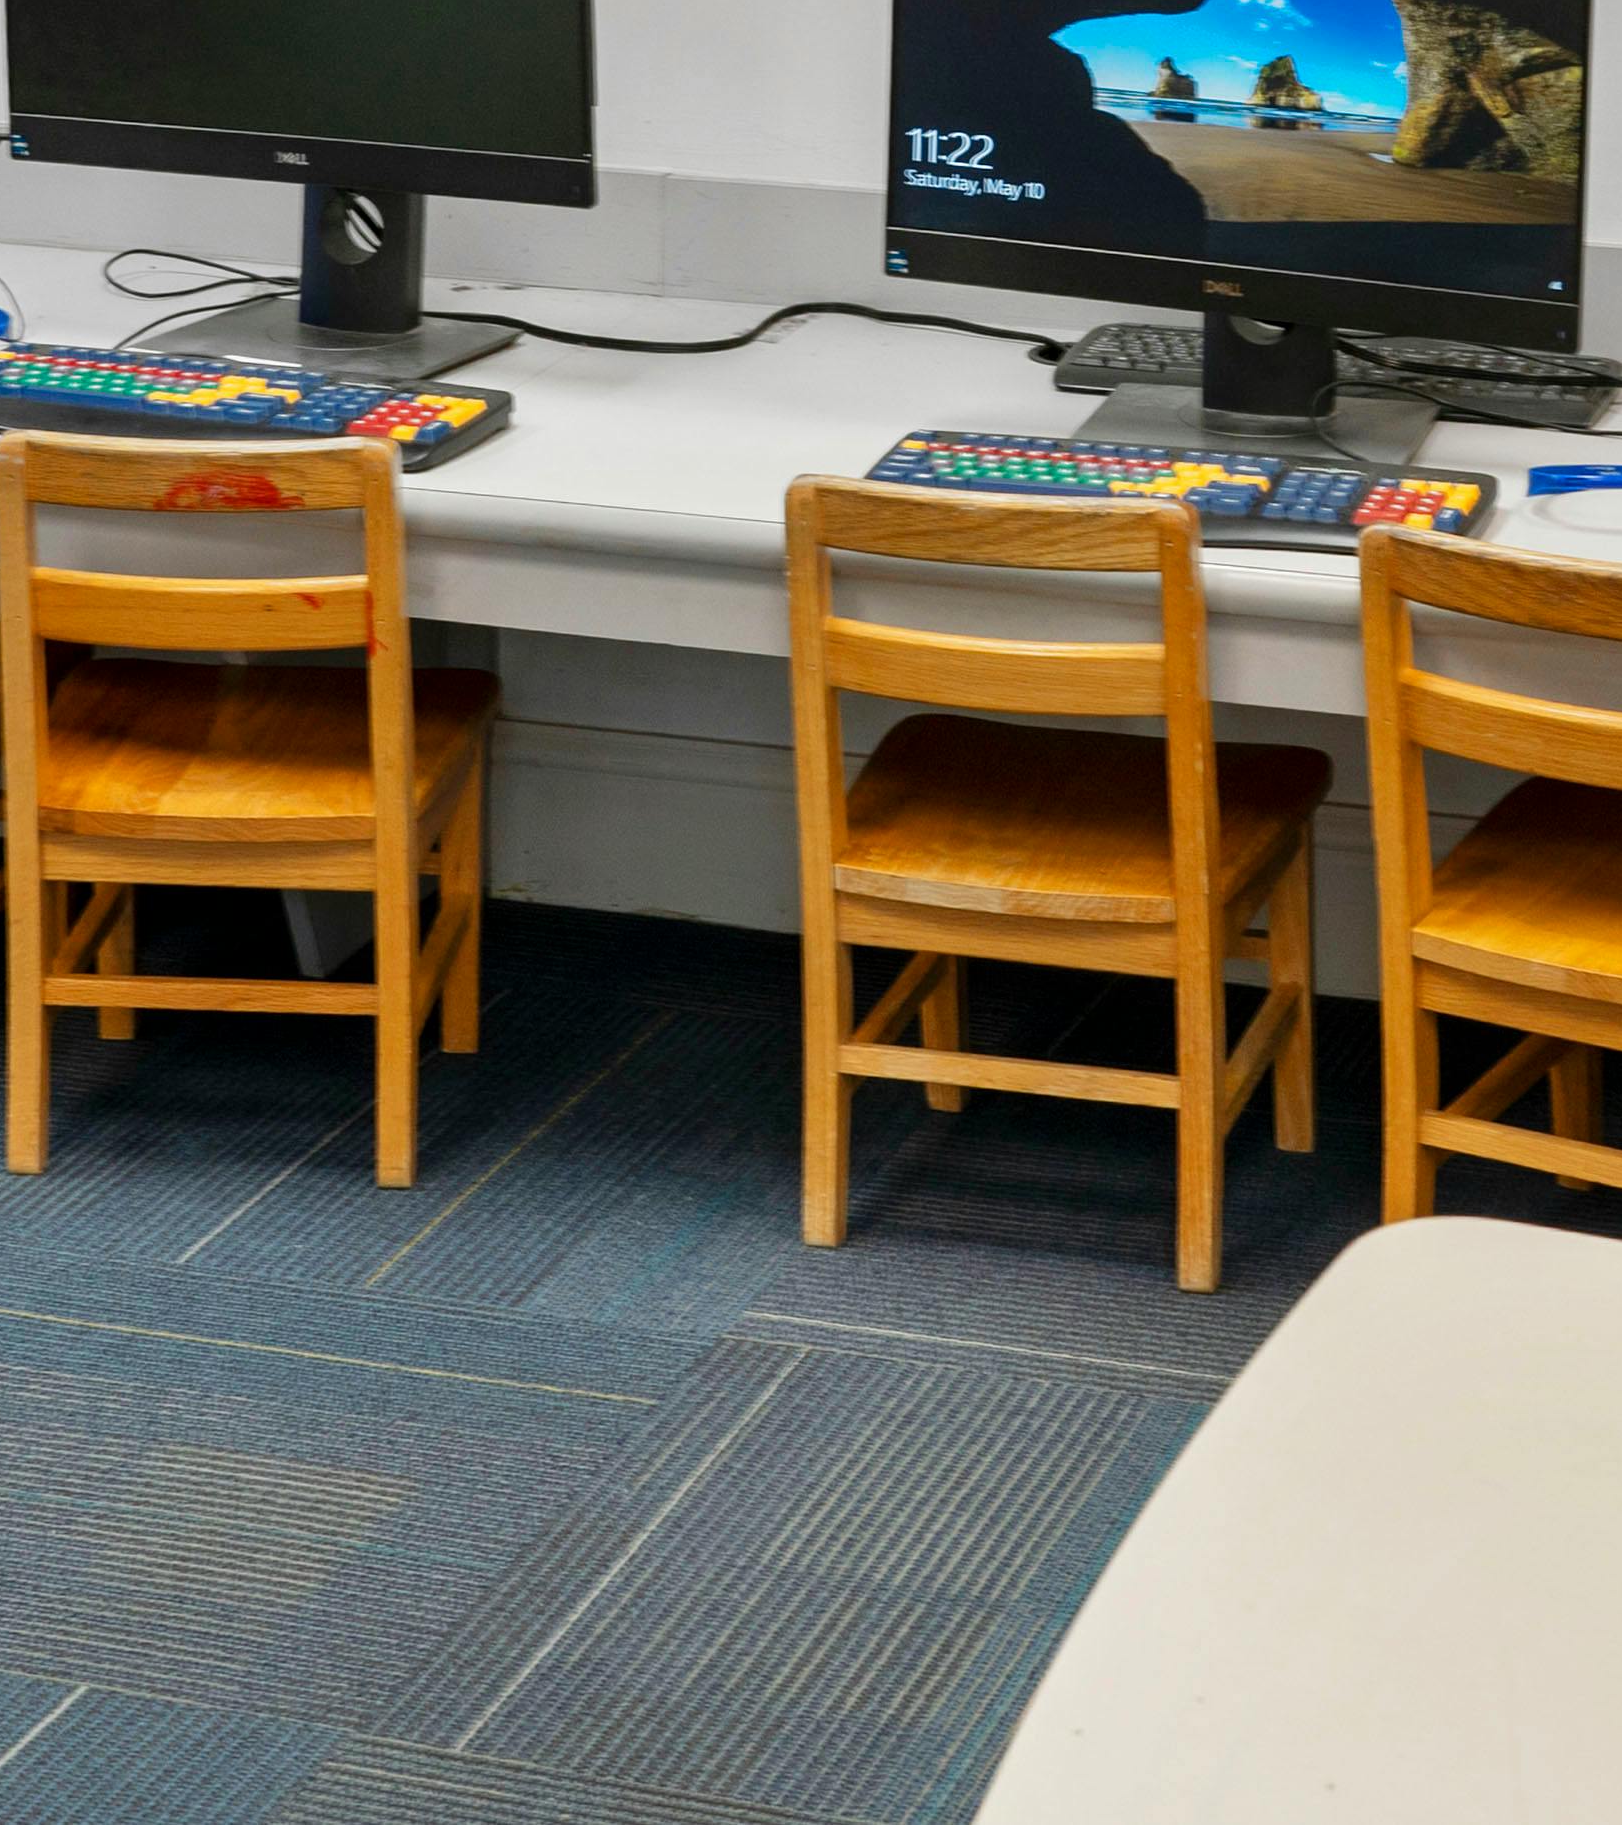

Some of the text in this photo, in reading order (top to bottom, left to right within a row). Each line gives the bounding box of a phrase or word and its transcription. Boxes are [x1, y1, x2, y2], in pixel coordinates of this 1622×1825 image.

[905, 127, 995, 170] 11:22
[903, 168, 1046, 201] Saturday, May 10
[1202, 279, 1244, 297] DELL
